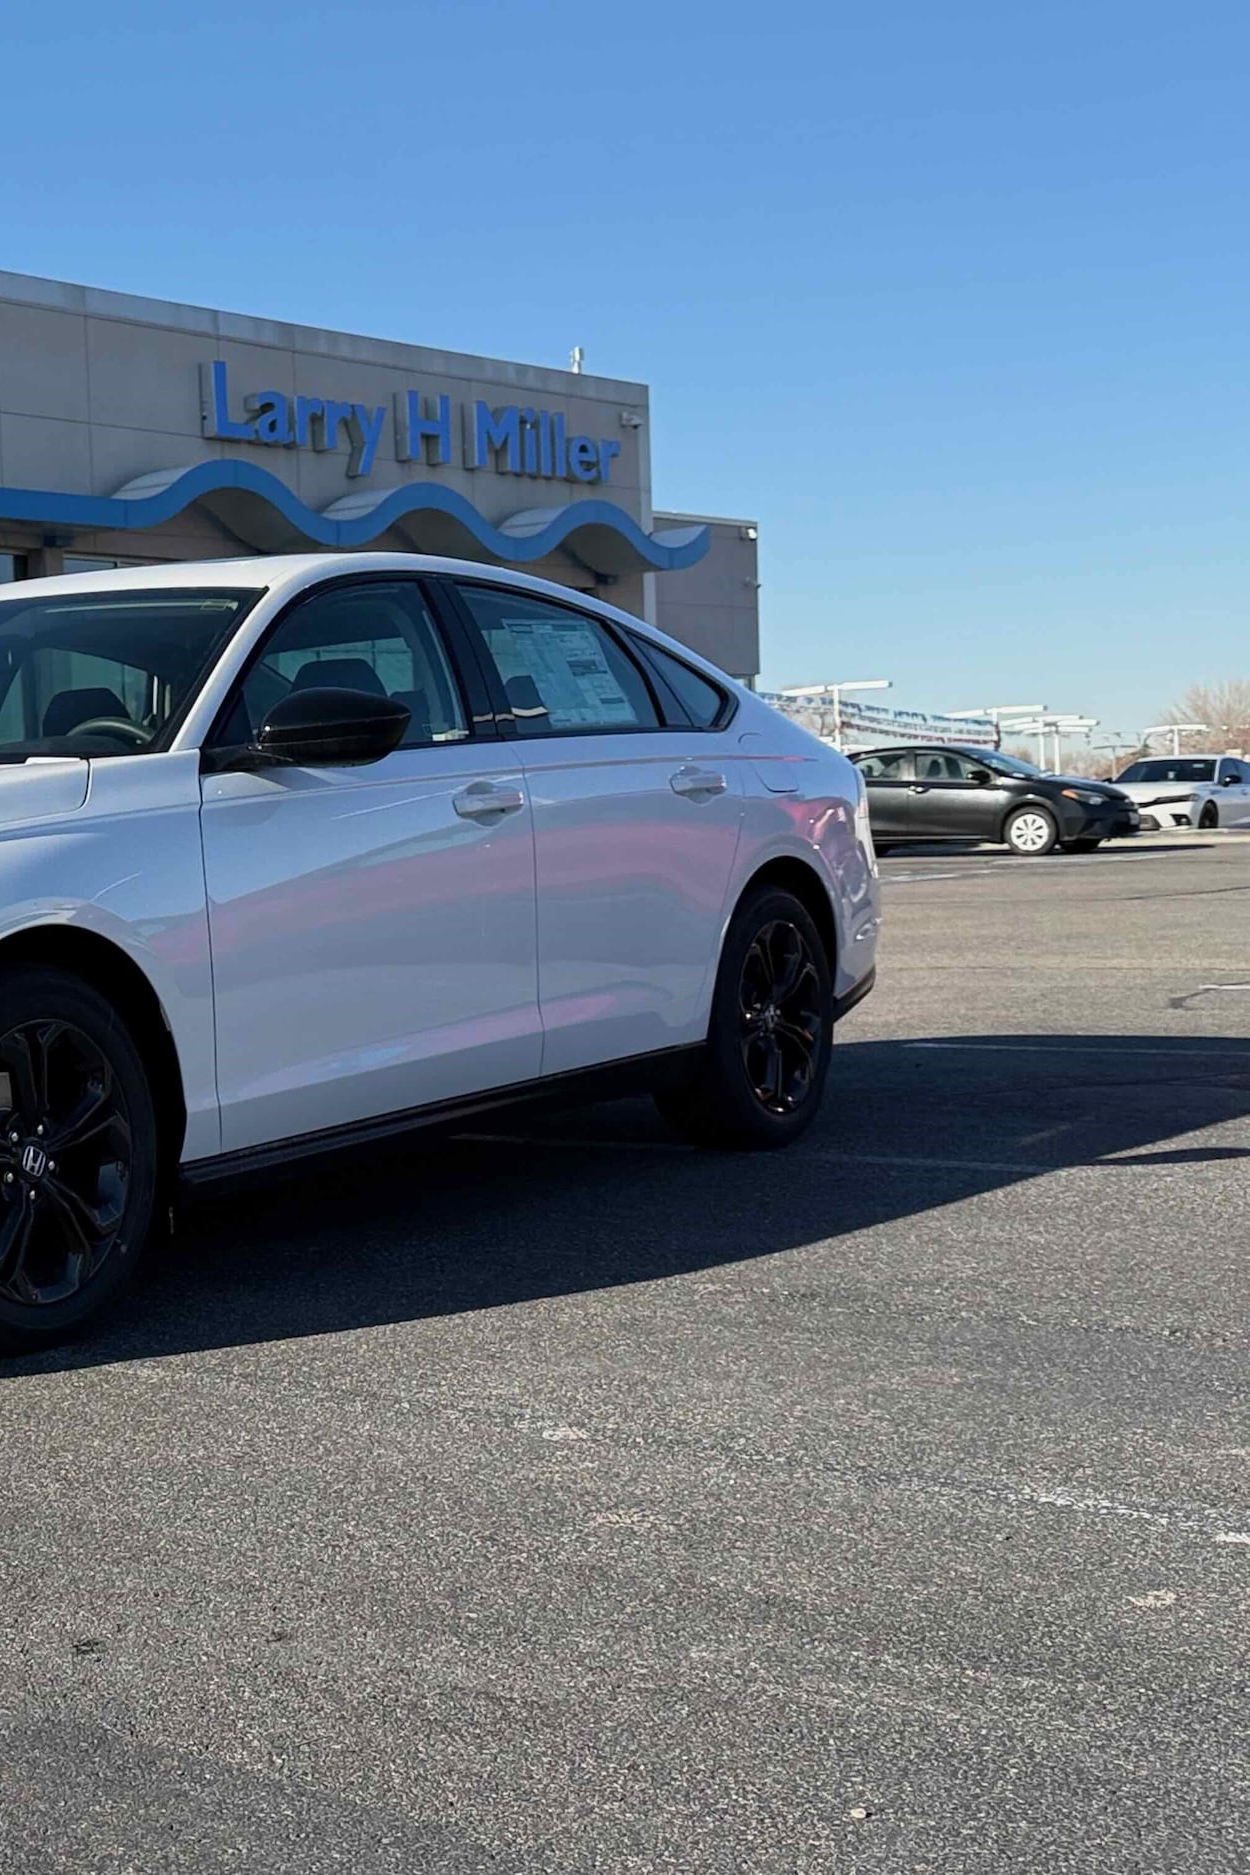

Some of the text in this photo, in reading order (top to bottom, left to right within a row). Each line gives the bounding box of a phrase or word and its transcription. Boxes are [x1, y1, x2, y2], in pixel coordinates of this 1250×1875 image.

[210, 360, 622, 482] Larry H Miller
